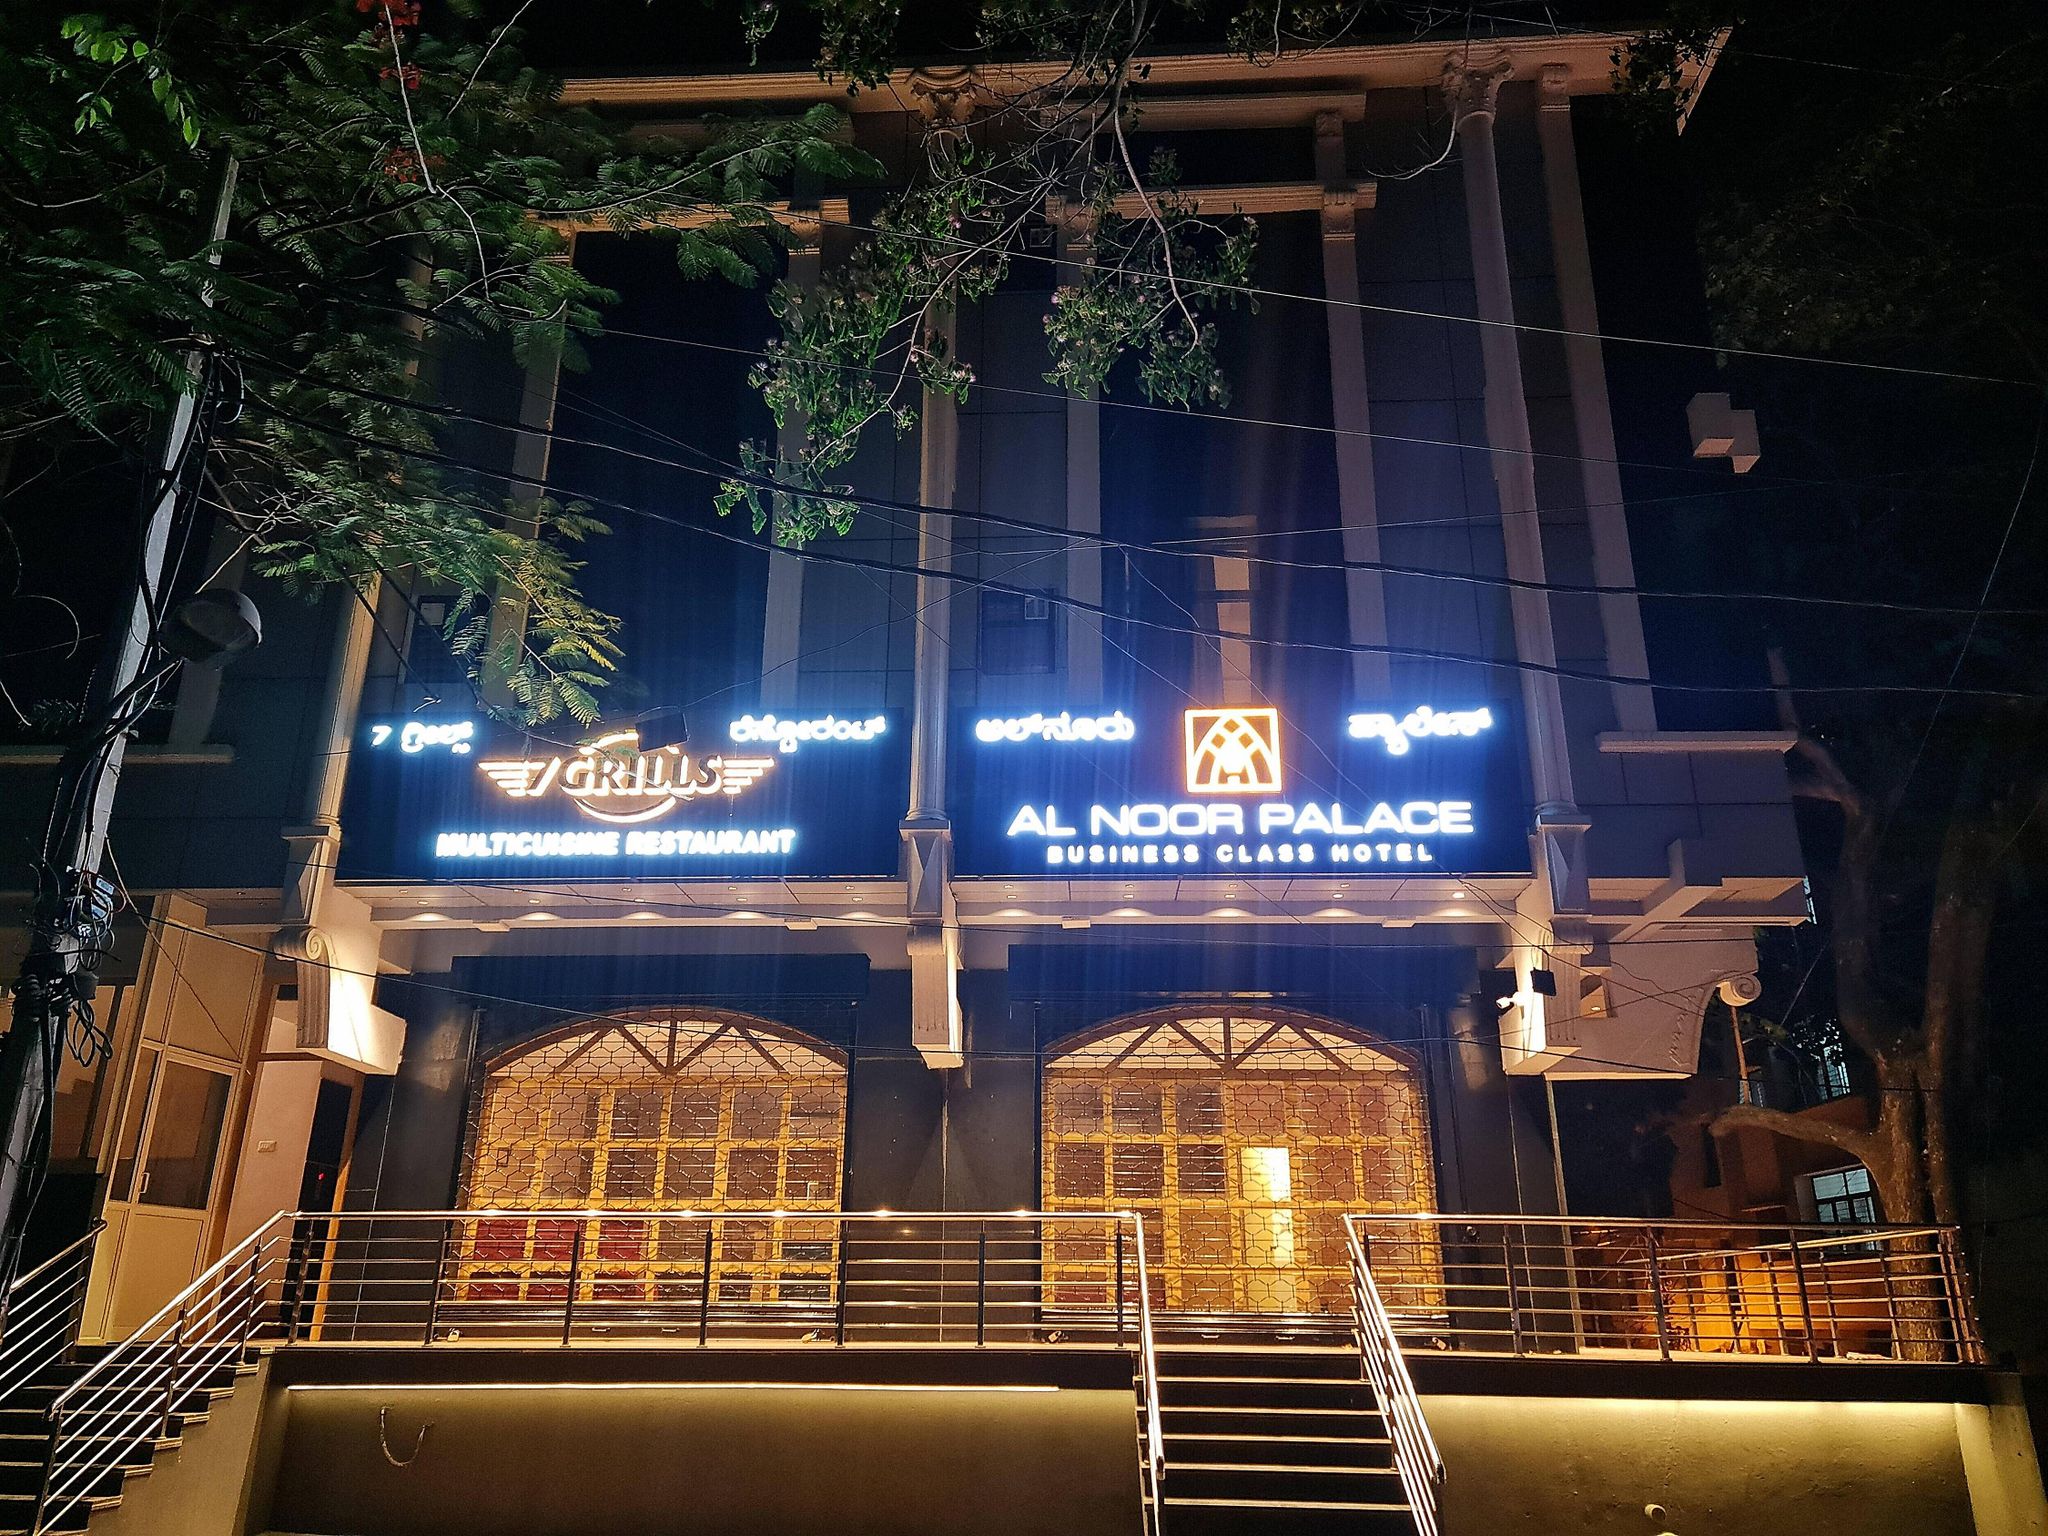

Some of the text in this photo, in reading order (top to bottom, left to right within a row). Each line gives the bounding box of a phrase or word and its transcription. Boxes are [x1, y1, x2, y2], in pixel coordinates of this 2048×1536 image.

[371, 725, 392, 746] 7
[558, 755, 723, 797] GRILLS
[1006, 801, 1475, 837] AL NOOR PALACE
[434, 827, 797, 859] MULTICUISINE RESTAURANT
[1046, 842, 1434, 864] BUSINESS CLASS HOTEL
